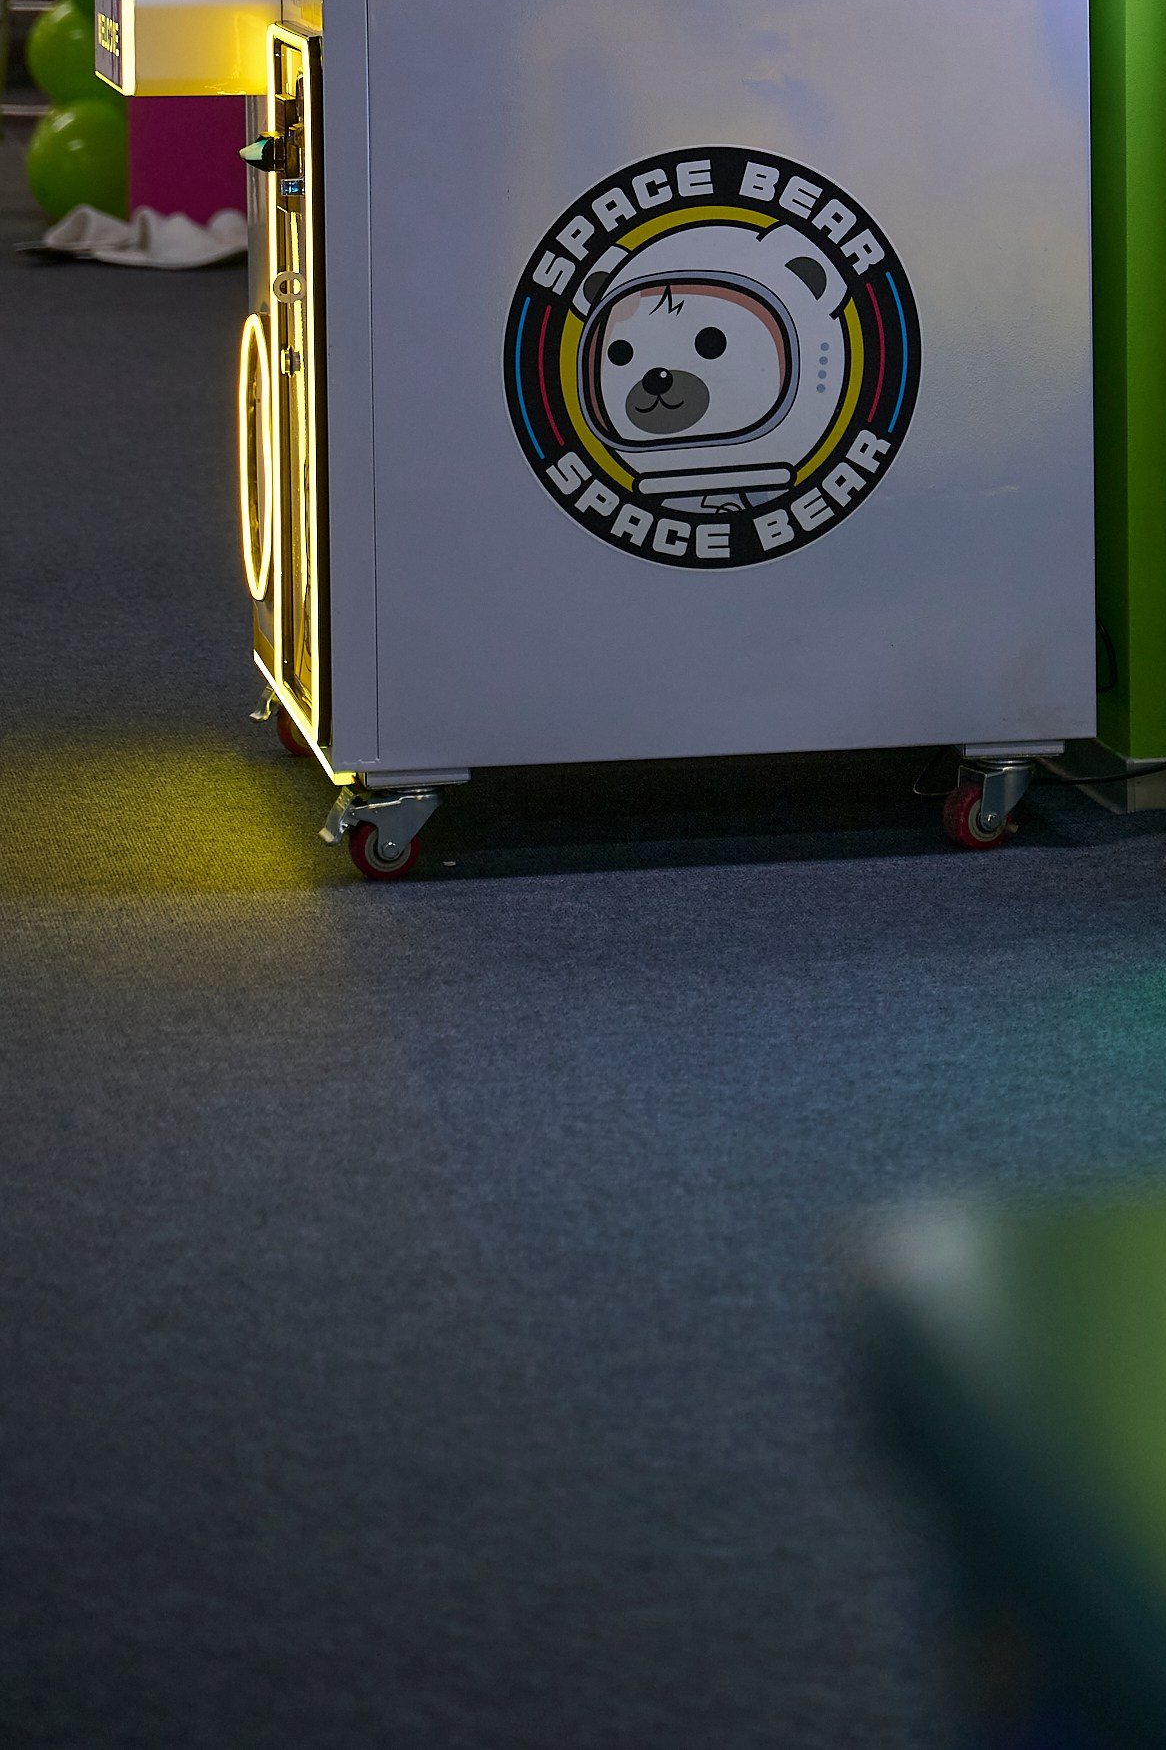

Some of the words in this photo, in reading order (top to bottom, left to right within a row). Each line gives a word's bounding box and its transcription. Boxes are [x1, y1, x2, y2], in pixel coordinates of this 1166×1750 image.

[533, 160, 713, 295] SPACE
[739, 161, 884, 276] BEAR
[546, 451, 731, 558] SPACE
[753, 429, 891, 551] BEAR
